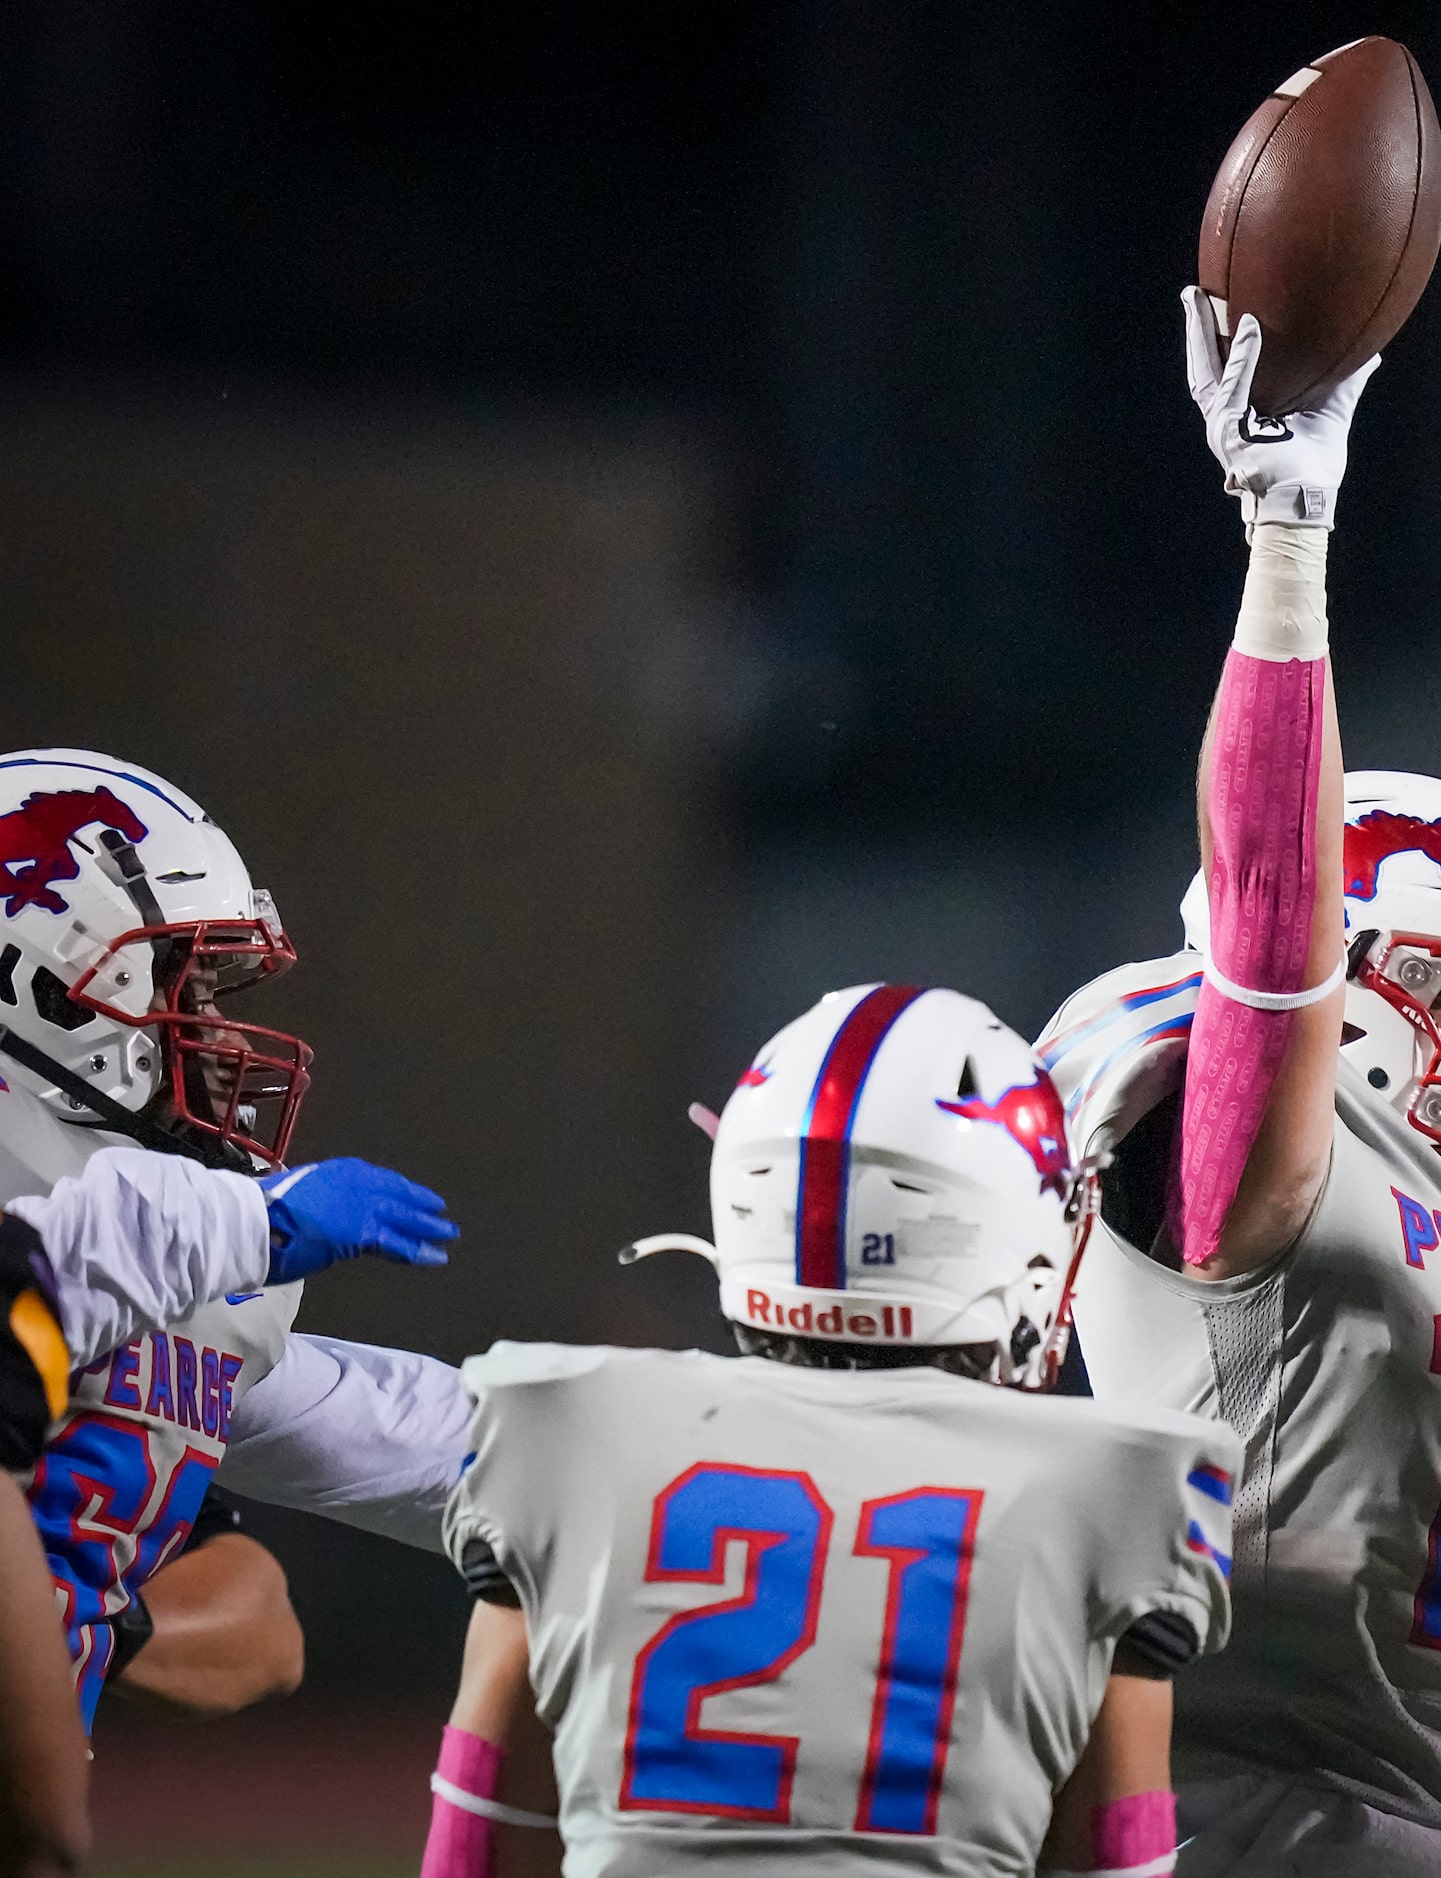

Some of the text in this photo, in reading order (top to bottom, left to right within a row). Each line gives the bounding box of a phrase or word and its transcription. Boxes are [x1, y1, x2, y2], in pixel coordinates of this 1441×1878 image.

[1209, 1062, 1236, 1115] BATTLE
[862, 1232, 895, 1266] 21
[747, 1288, 913, 1338] Riddell
[618, 1460, 985, 1836] 21
